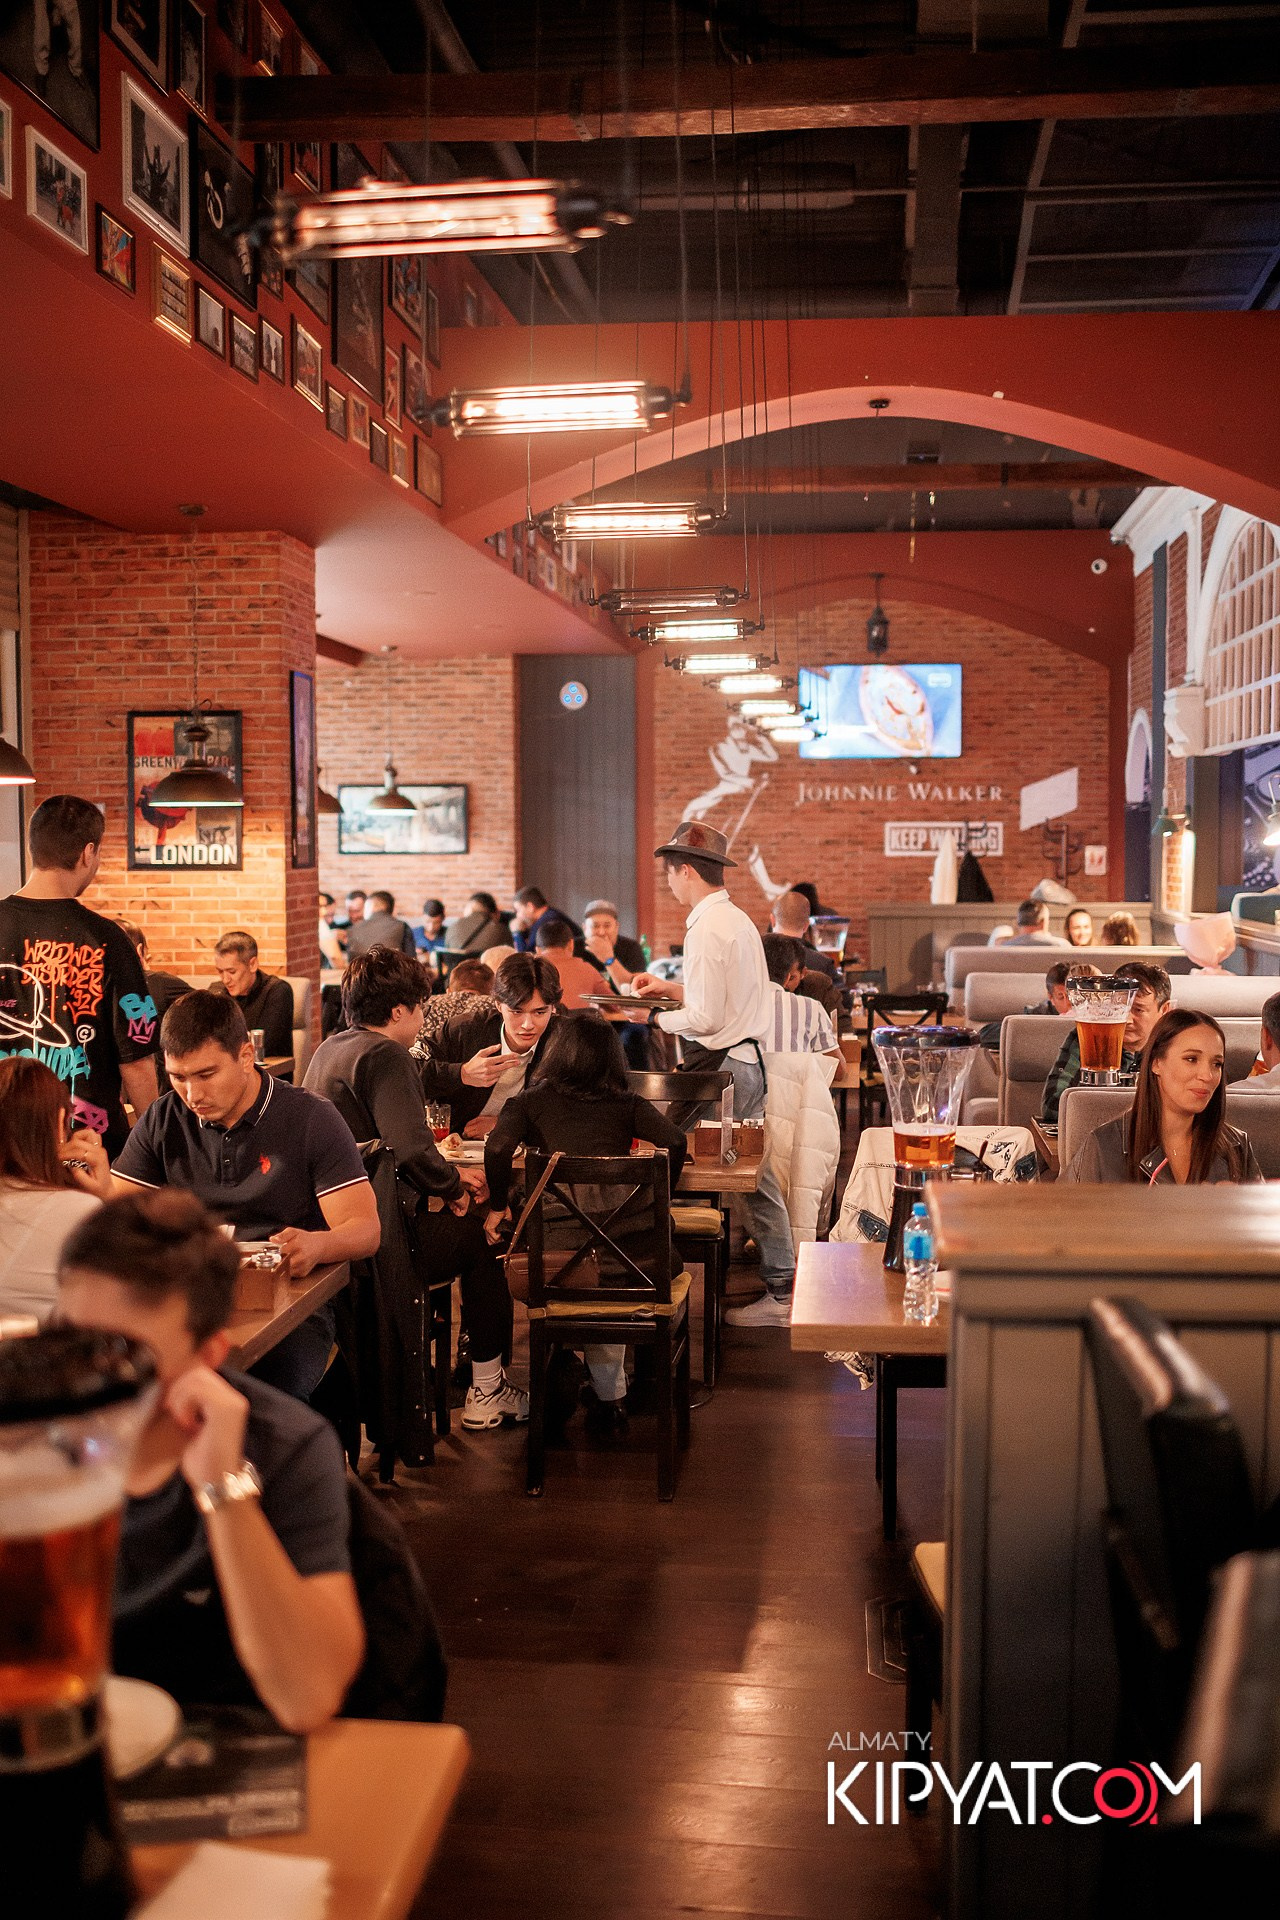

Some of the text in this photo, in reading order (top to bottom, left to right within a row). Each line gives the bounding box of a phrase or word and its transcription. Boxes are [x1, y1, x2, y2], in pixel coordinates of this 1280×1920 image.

[795, 782, 1003, 807] JOHNNIE WALKER
[890, 828, 999, 850] KEEP WLING
[149, 844, 238, 865] LONDON
